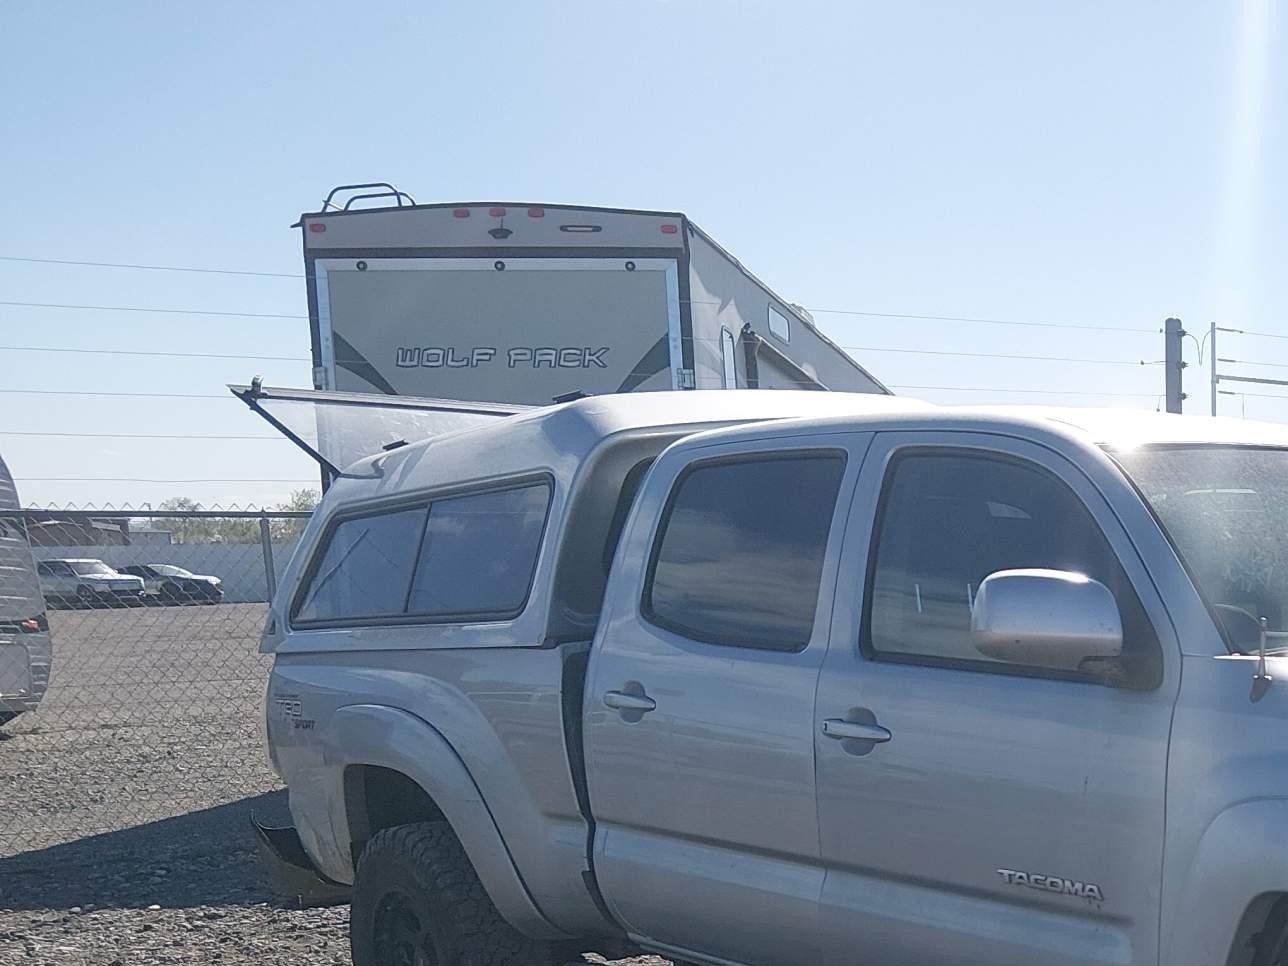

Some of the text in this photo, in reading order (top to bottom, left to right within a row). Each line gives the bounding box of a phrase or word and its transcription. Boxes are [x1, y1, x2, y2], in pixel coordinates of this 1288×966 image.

[396, 347, 610, 369] WOLF PACK
[996, 867, 1104, 902] TACOMA
